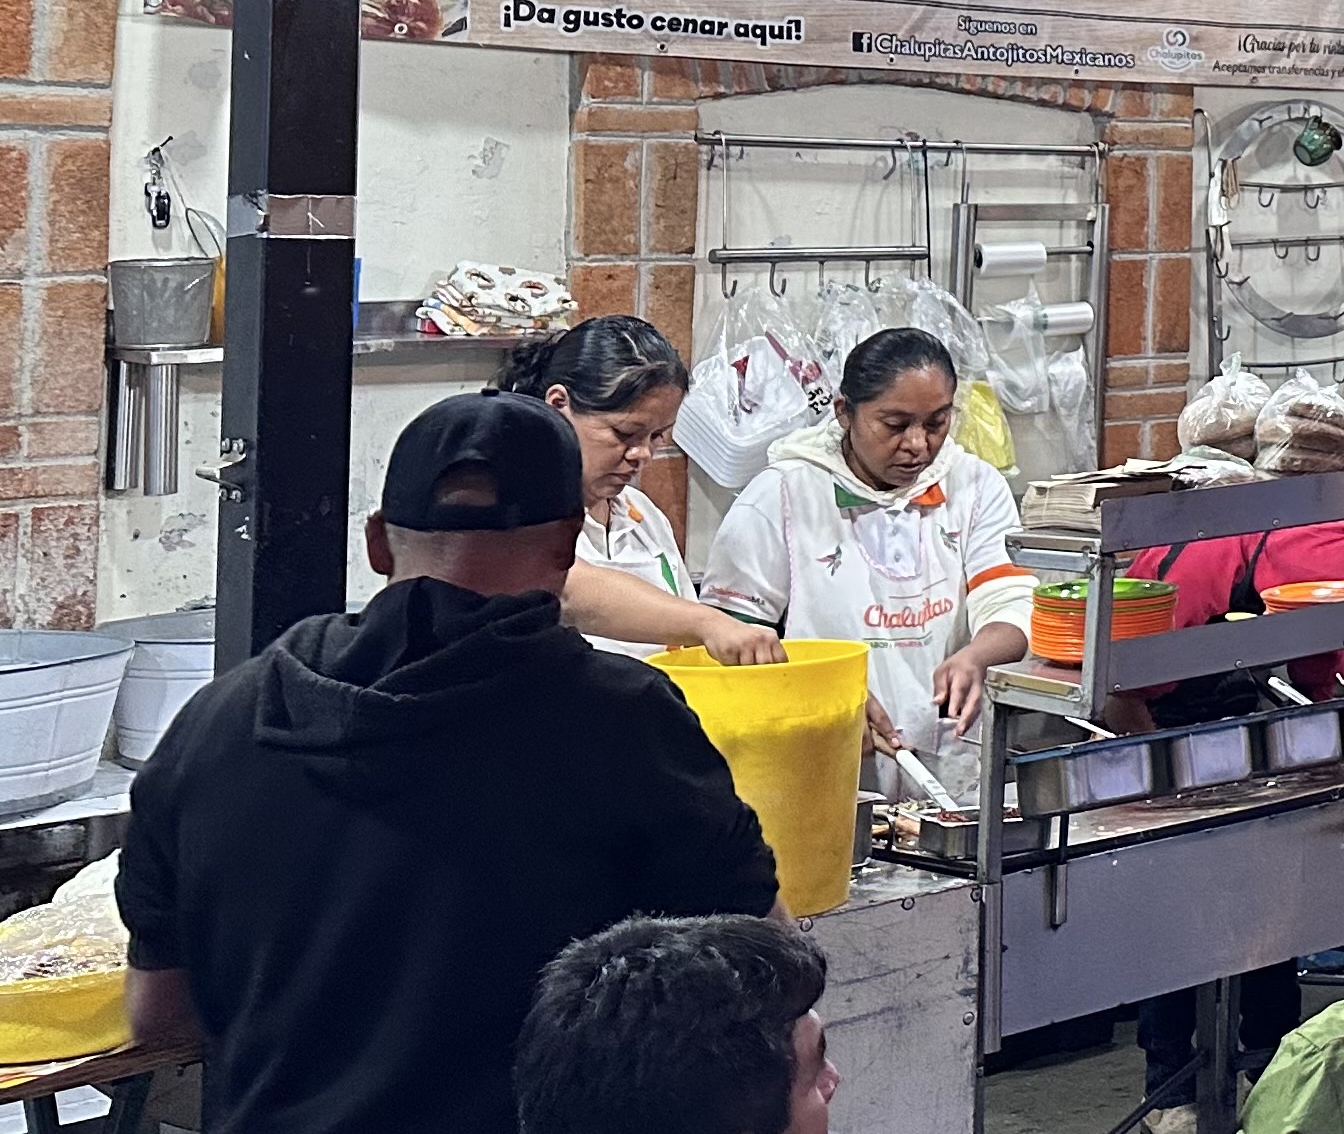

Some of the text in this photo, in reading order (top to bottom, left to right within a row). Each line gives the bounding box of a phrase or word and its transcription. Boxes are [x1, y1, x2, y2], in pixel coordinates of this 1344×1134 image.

[562, 4, 645, 33] gusto
[649, 13, 729, 38] cenar
[733, 19, 802, 47] aquí!
[957, 16, 1037, 35] Síguenos en
[874, 34, 1136, 68] ChalupitasAntojitosMexicanos
